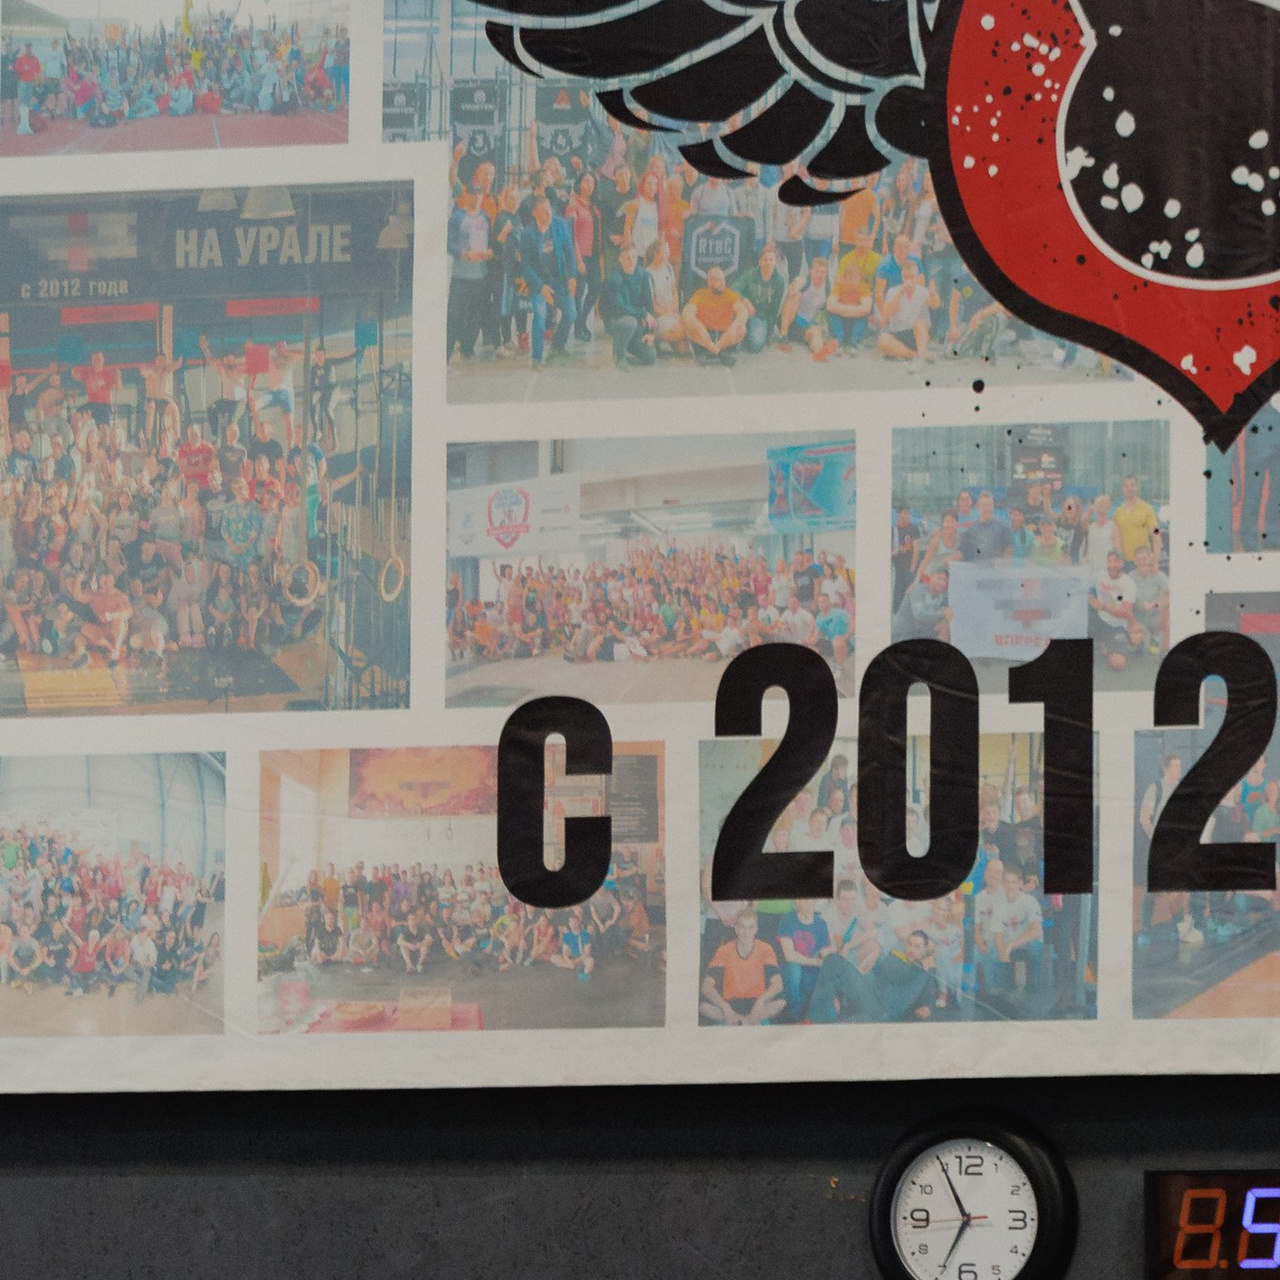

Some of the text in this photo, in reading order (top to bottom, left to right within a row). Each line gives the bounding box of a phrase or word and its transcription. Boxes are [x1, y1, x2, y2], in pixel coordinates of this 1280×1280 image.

[175, 223, 352, 270] НА УРАЛЕ
[38, 277, 81, 299] 2012
[711, 630, 1278, 902] 2012
[954, 1155, 984, 1176] 12
[919, 1184, 933, 1195] 10
[1010, 1185, 1021, 1196] 2
[910, 1208, 930, 1229] 9
[1008, 1209, 1027, 1230] 3
